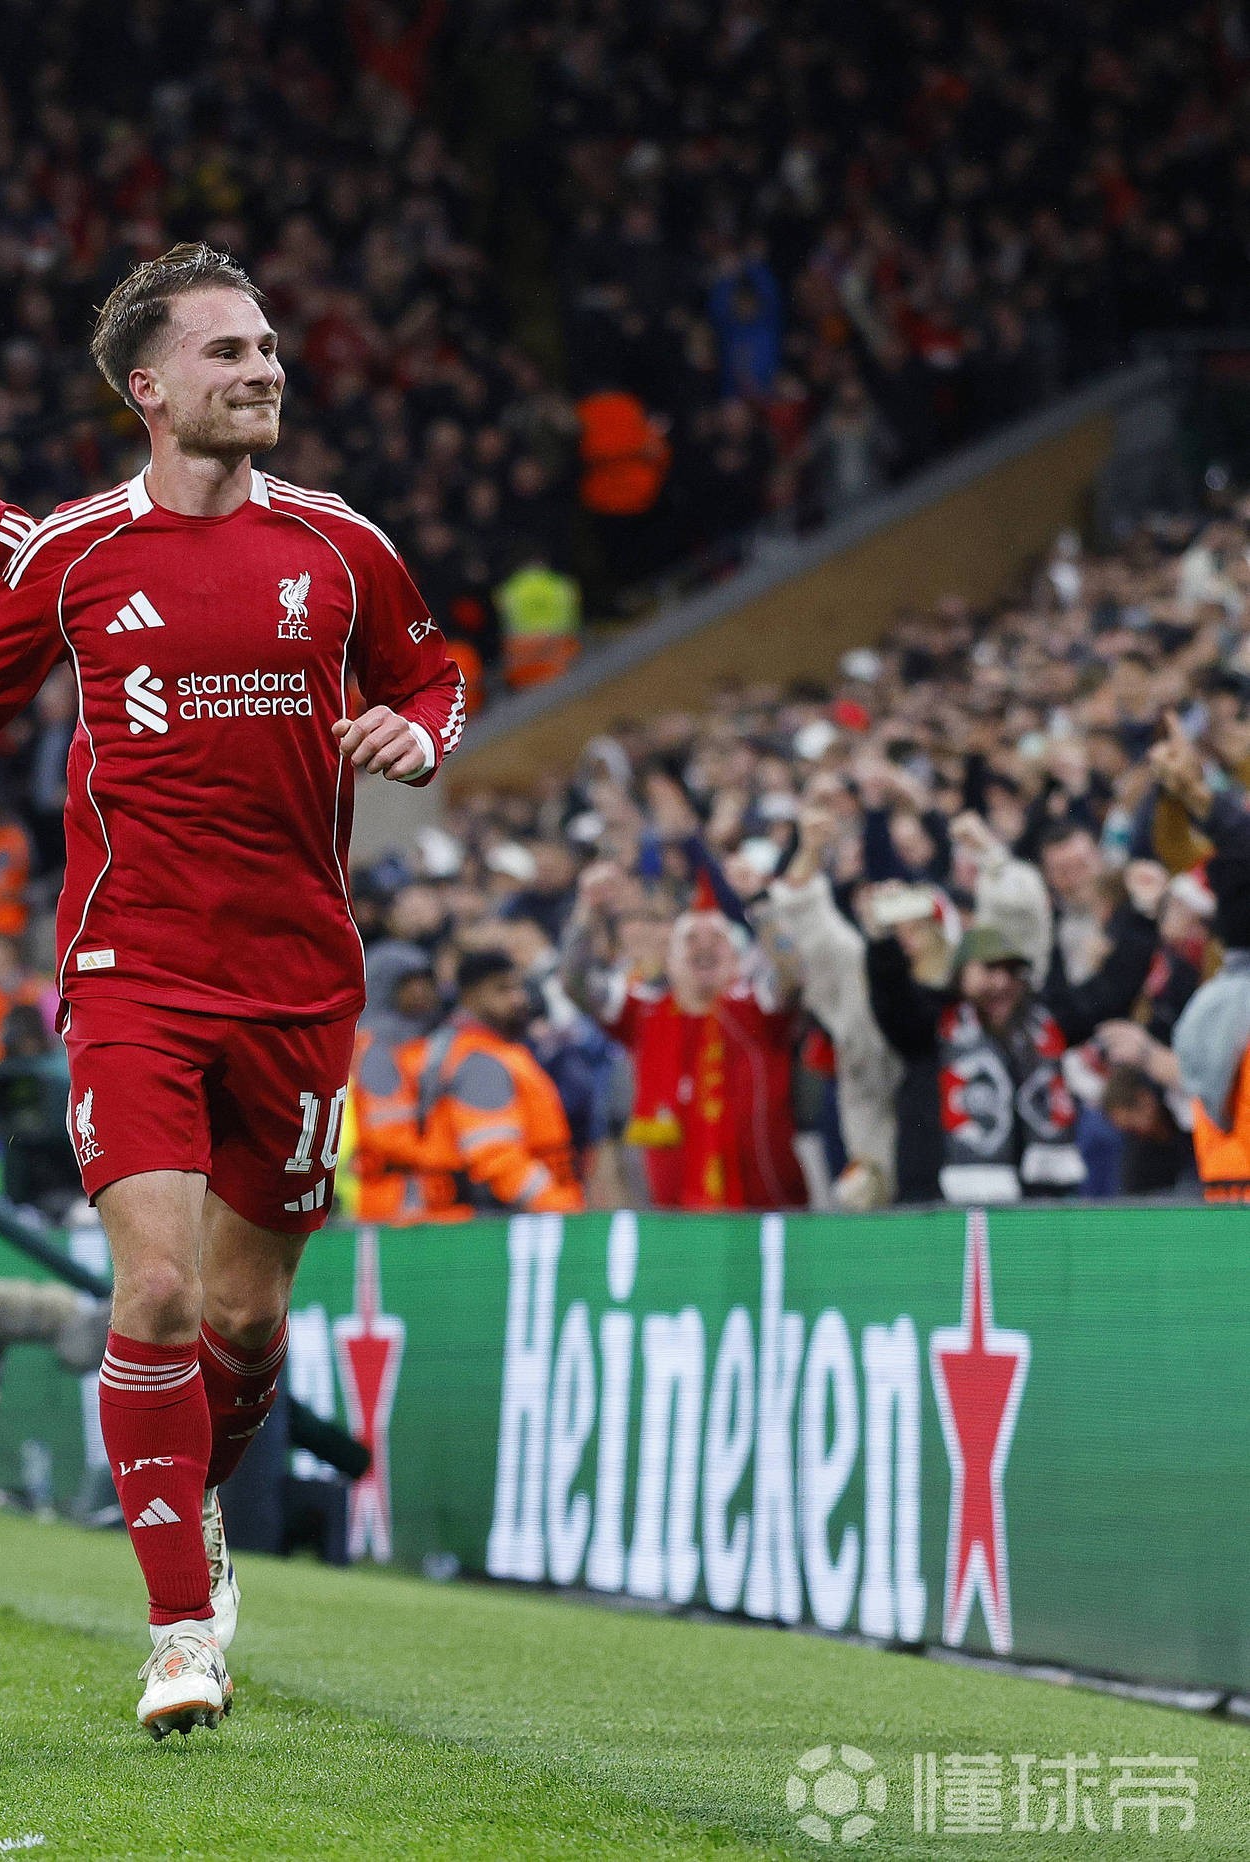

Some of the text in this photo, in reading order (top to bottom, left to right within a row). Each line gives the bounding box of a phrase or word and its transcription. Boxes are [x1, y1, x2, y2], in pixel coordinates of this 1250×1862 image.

[277, 624, 312, 641] L.F.C.
[177, 668, 306, 696] standard
[179, 693, 313, 720] chartered
[284, 1084, 348, 1173] 10
[485, 1210, 928, 1644] Heineken
